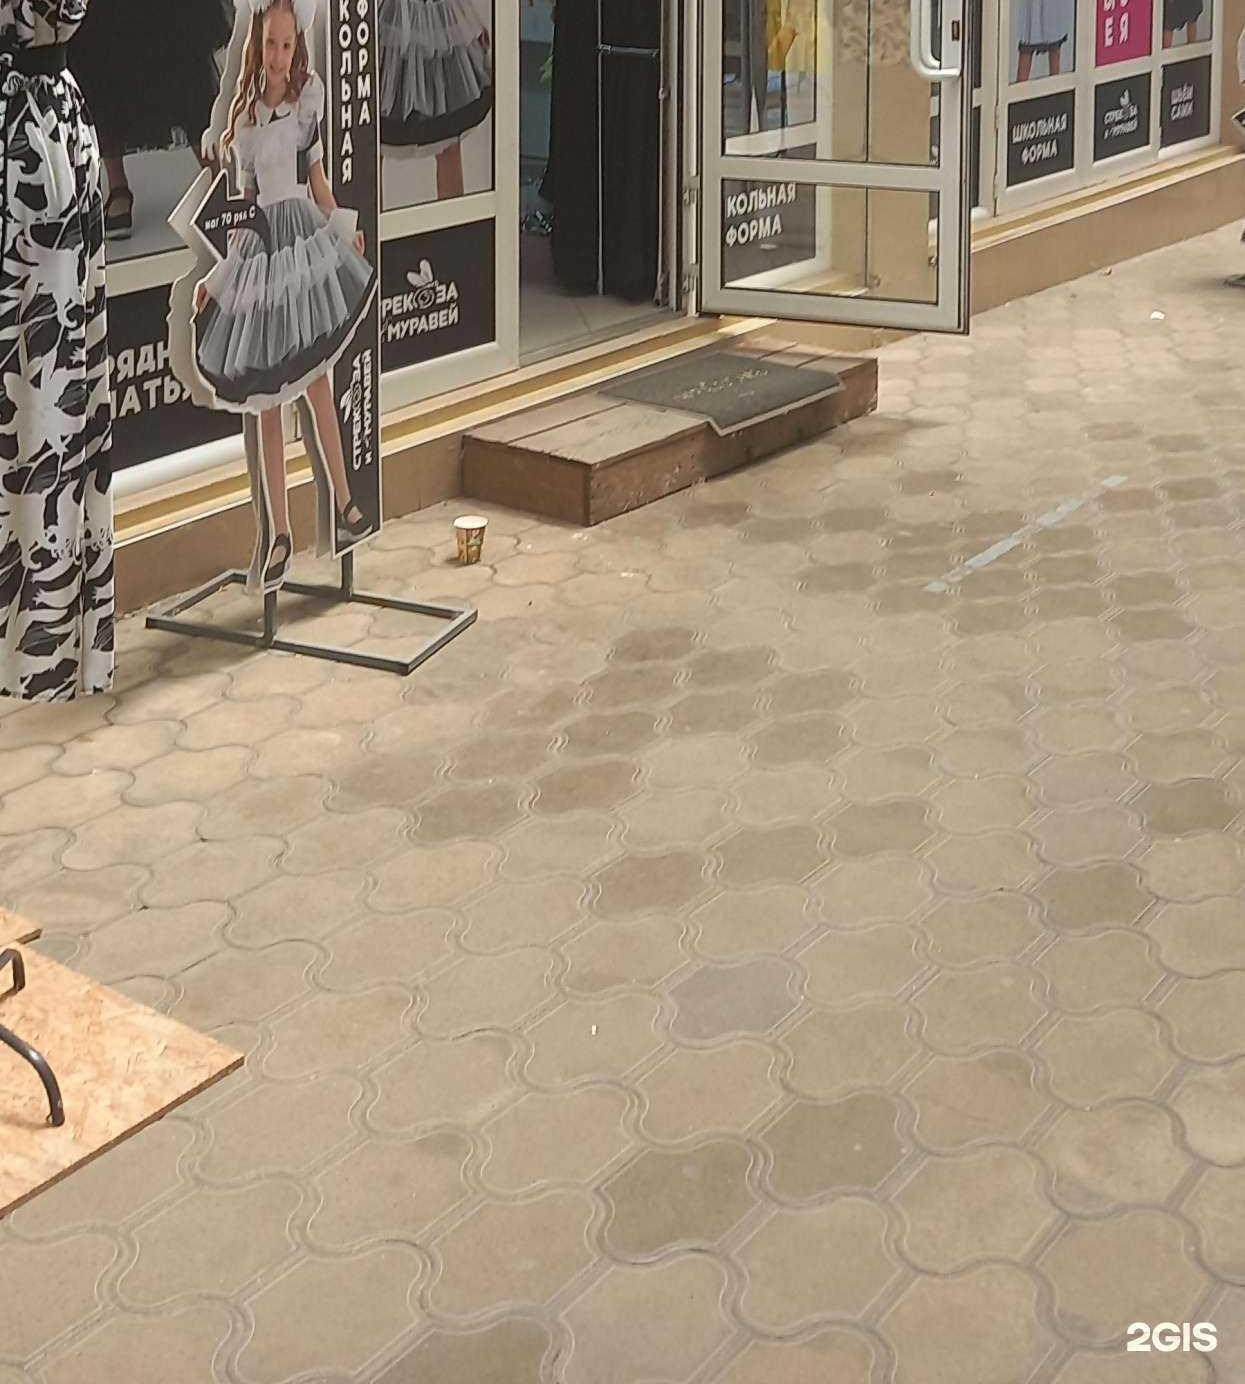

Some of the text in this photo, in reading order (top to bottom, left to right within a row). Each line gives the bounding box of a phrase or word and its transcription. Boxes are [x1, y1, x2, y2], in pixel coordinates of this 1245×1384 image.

[1012, 113, 1068, 144] ШКОЛЬНАЯ
[1021, 139, 1058, 166] ФОРМА
[727, 181, 796, 218] КОЛЬНАЯ
[221, 211, 232, 226] 70
[725, 213, 782, 248] ФОРМА
[387, 301, 459, 342] МУРАВЕЙ
